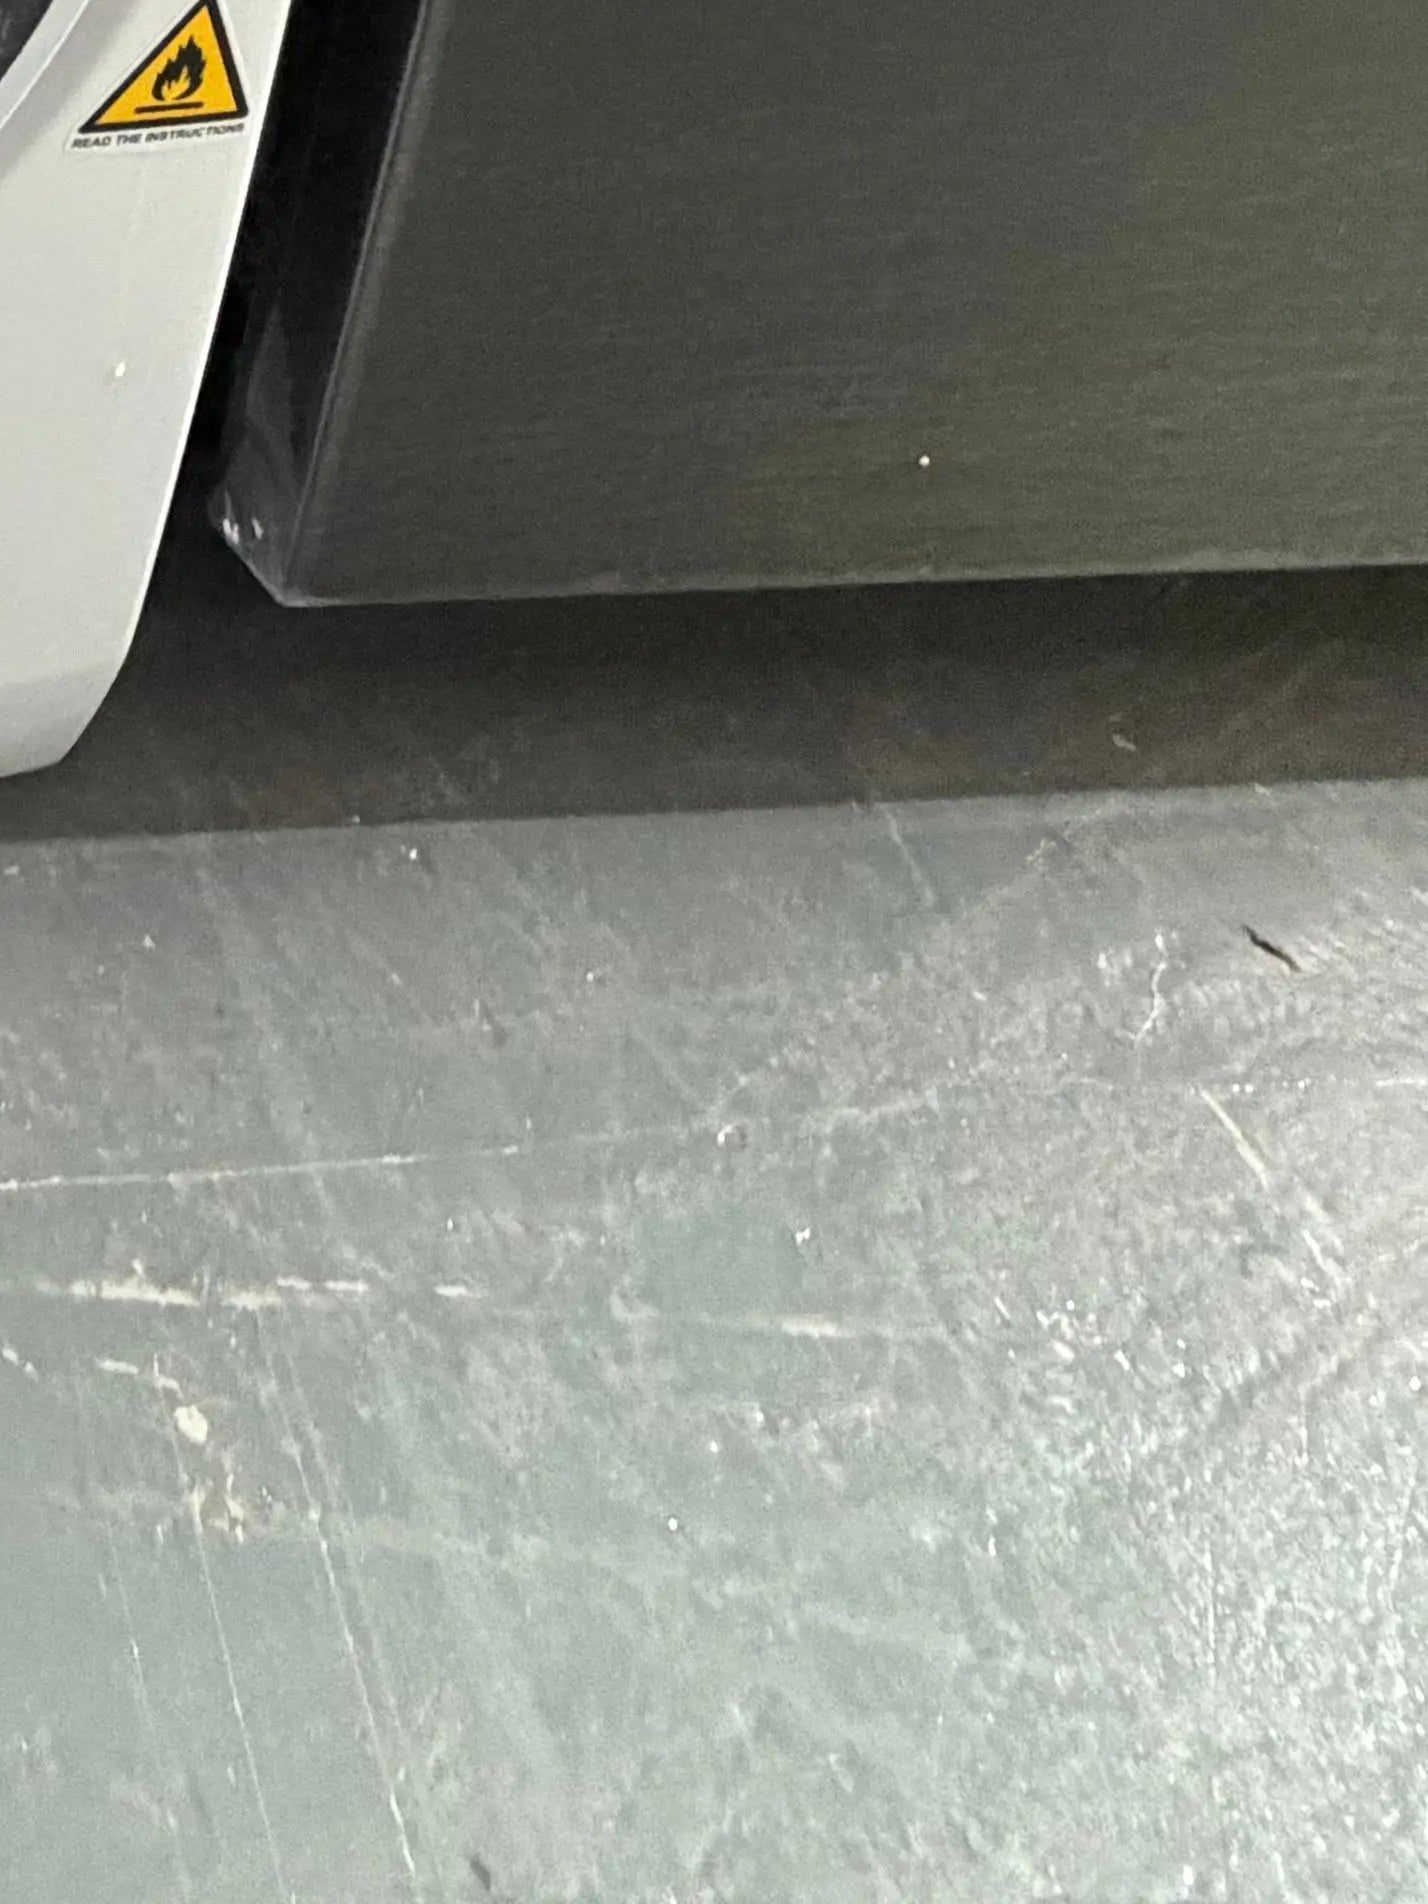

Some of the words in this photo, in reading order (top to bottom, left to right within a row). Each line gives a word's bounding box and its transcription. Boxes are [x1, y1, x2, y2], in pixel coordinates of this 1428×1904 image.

[70, 135, 112, 150] READ
[115, 132, 143, 148] THE
[144, 123, 245, 143] INSTRUCTIONS
